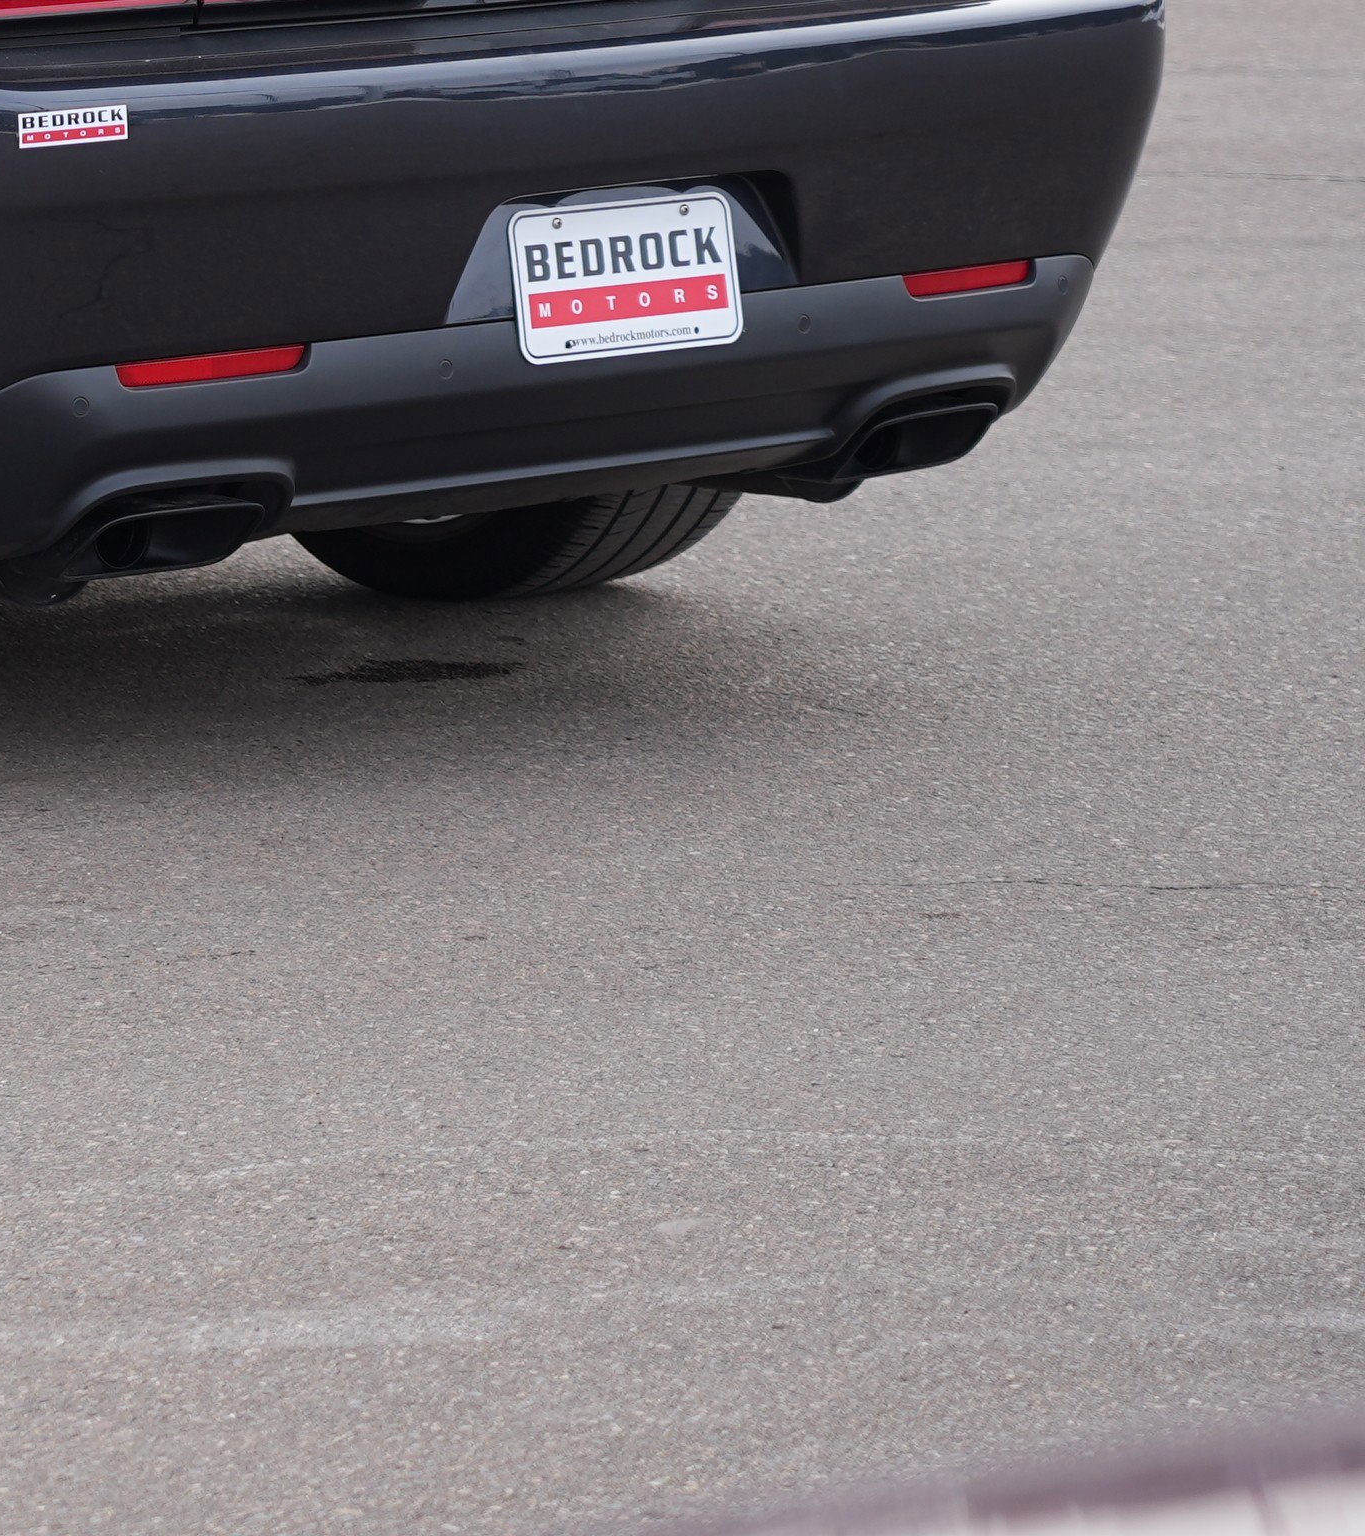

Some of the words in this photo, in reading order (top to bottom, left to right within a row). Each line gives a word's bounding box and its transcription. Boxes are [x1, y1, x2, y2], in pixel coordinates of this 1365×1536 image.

[22, 108, 124, 130] BEDROCK
[26, 127, 122, 141] MOTORS
[524, 226, 723, 283] BEDROCK
[539, 284, 719, 318] MOTORS
[570, 325, 692, 347] www.bedrockmotors.com
